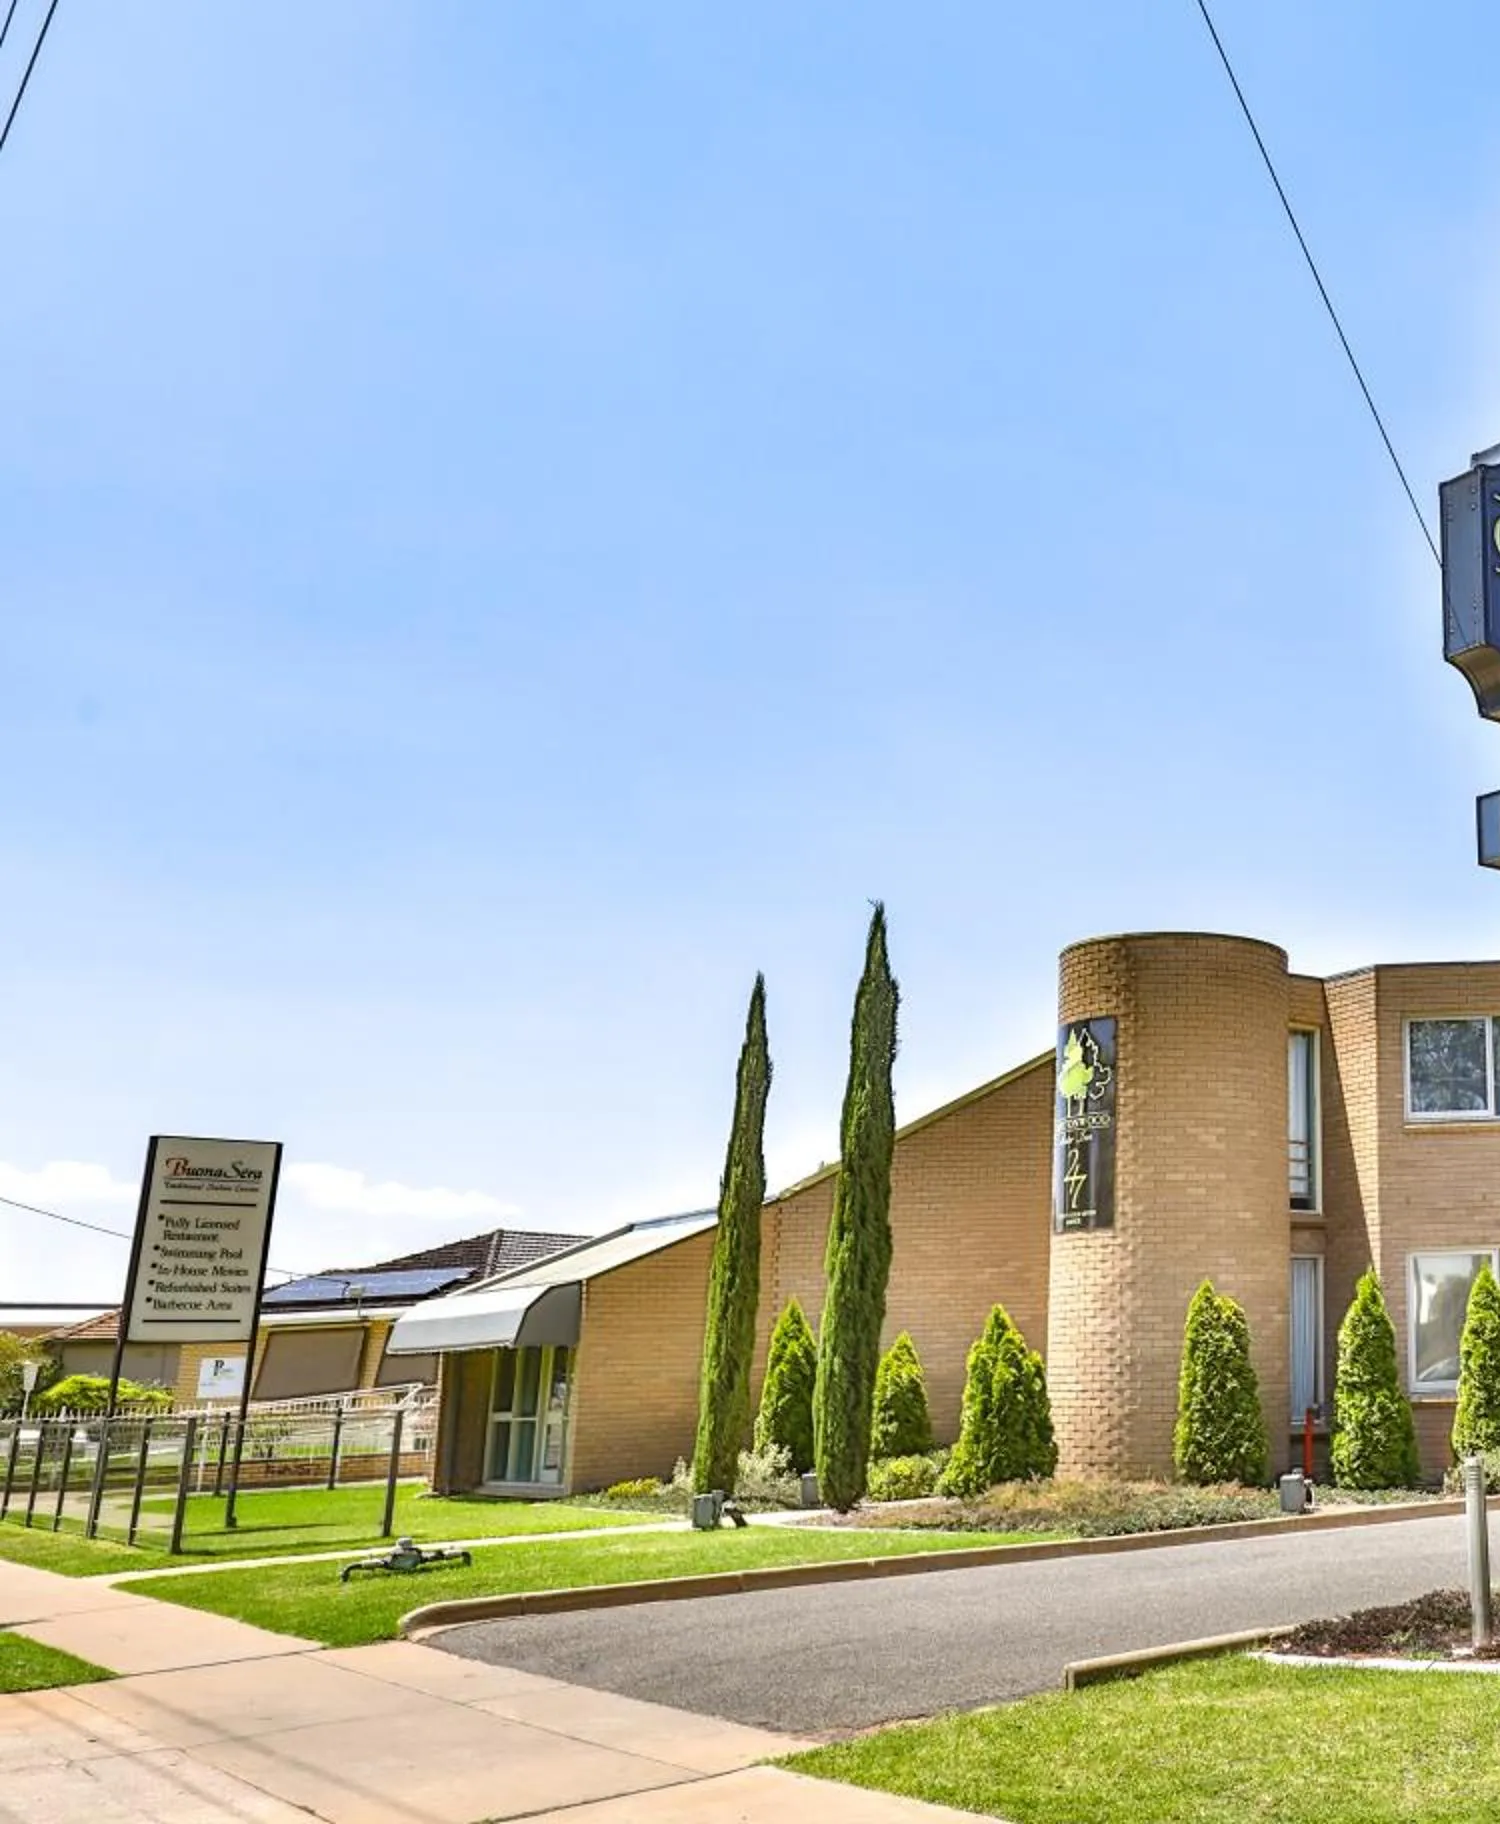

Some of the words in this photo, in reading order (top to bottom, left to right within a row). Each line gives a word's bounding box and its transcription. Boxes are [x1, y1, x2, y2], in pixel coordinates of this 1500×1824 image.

[165, 1157, 223, 1179] Buona
[223, 1161, 263, 1179] Sera
[165, 1217, 190, 1230] Fully
[195, 1219, 240, 1230] Licensed
[163, 1230, 219, 1241] Restaurant
[160, 1248, 216, 1260] Swimming
[220, 1249, 243, 1259] Pool
[212, 1266, 248, 1276] Movies
[154, 1281, 217, 1293] Refurbished
[220, 1282, 251, 1293] Suites
[153, 1299, 202, 1310] Barbecue
[206, 1300, 233, 1310] Area
